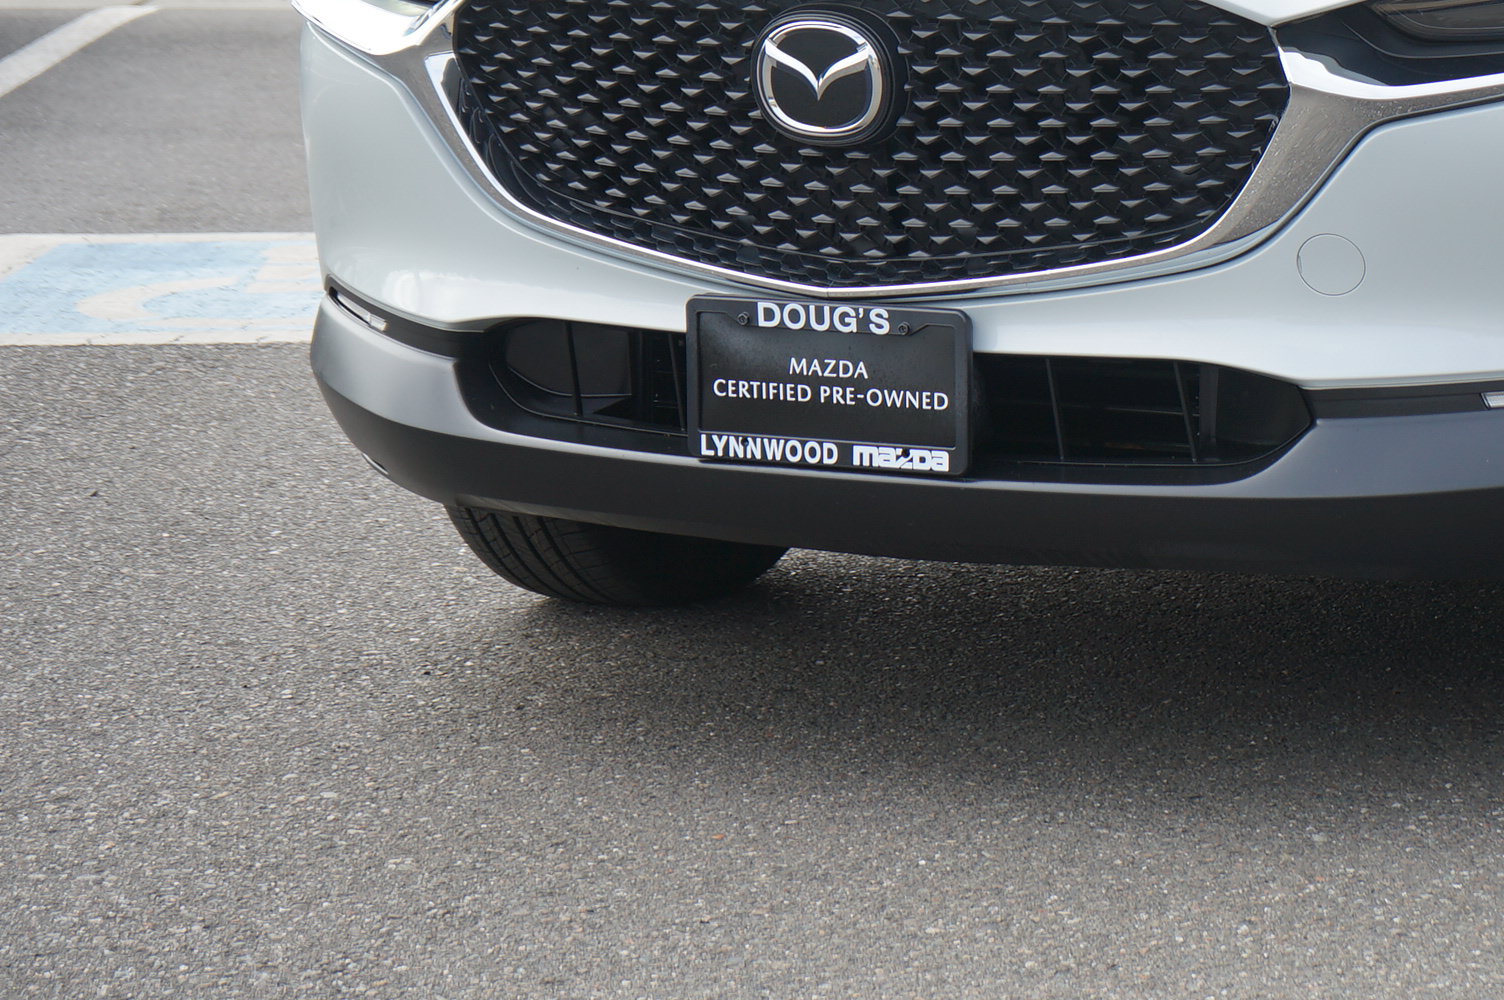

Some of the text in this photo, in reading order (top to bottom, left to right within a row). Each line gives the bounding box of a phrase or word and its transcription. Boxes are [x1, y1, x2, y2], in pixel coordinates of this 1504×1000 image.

[757, 301, 891, 335] DOUG'S
[789, 357, 868, 379] MAZDA
[713, 379, 948, 410] CERTIFIED PRE-OWNED
[700, 434, 838, 465] LYNNWOOD
